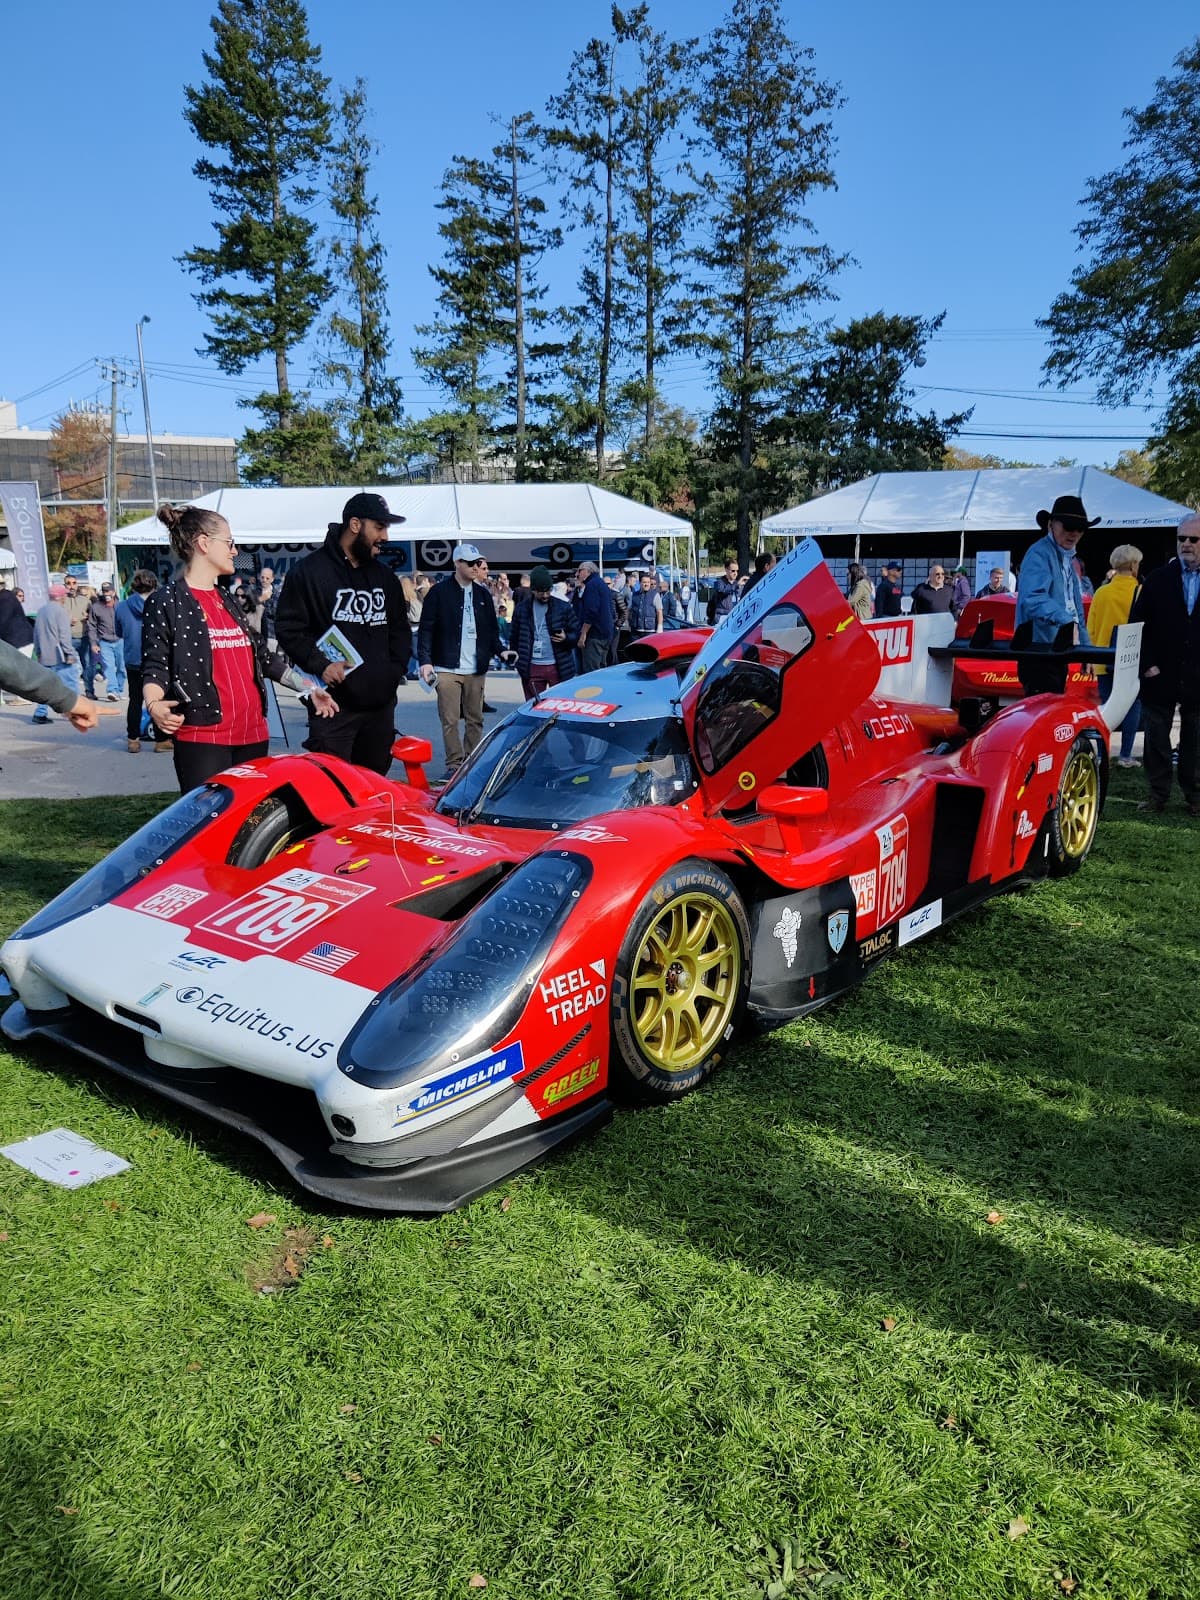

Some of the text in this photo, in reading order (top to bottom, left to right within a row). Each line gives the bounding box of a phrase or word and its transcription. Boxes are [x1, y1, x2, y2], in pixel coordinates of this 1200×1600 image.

[537, 699, 609, 715] MOTUL
[376, 830, 488, 857] MOTORCARS
[161, 885, 202, 902] HYPER
[676, 873, 729, 895] MICHELIN
[881, 850, 907, 920] 709
[142, 896, 186, 915] CAR
[212, 888, 329, 943] 709
[539, 967, 591, 1004] HEEL
[546, 984, 607, 1026] TREAD
[196, 993, 334, 1060] Equitus.us
[417, 1059, 507, 1108] MICHELIN
[543, 1058, 600, 1102] GREEN
